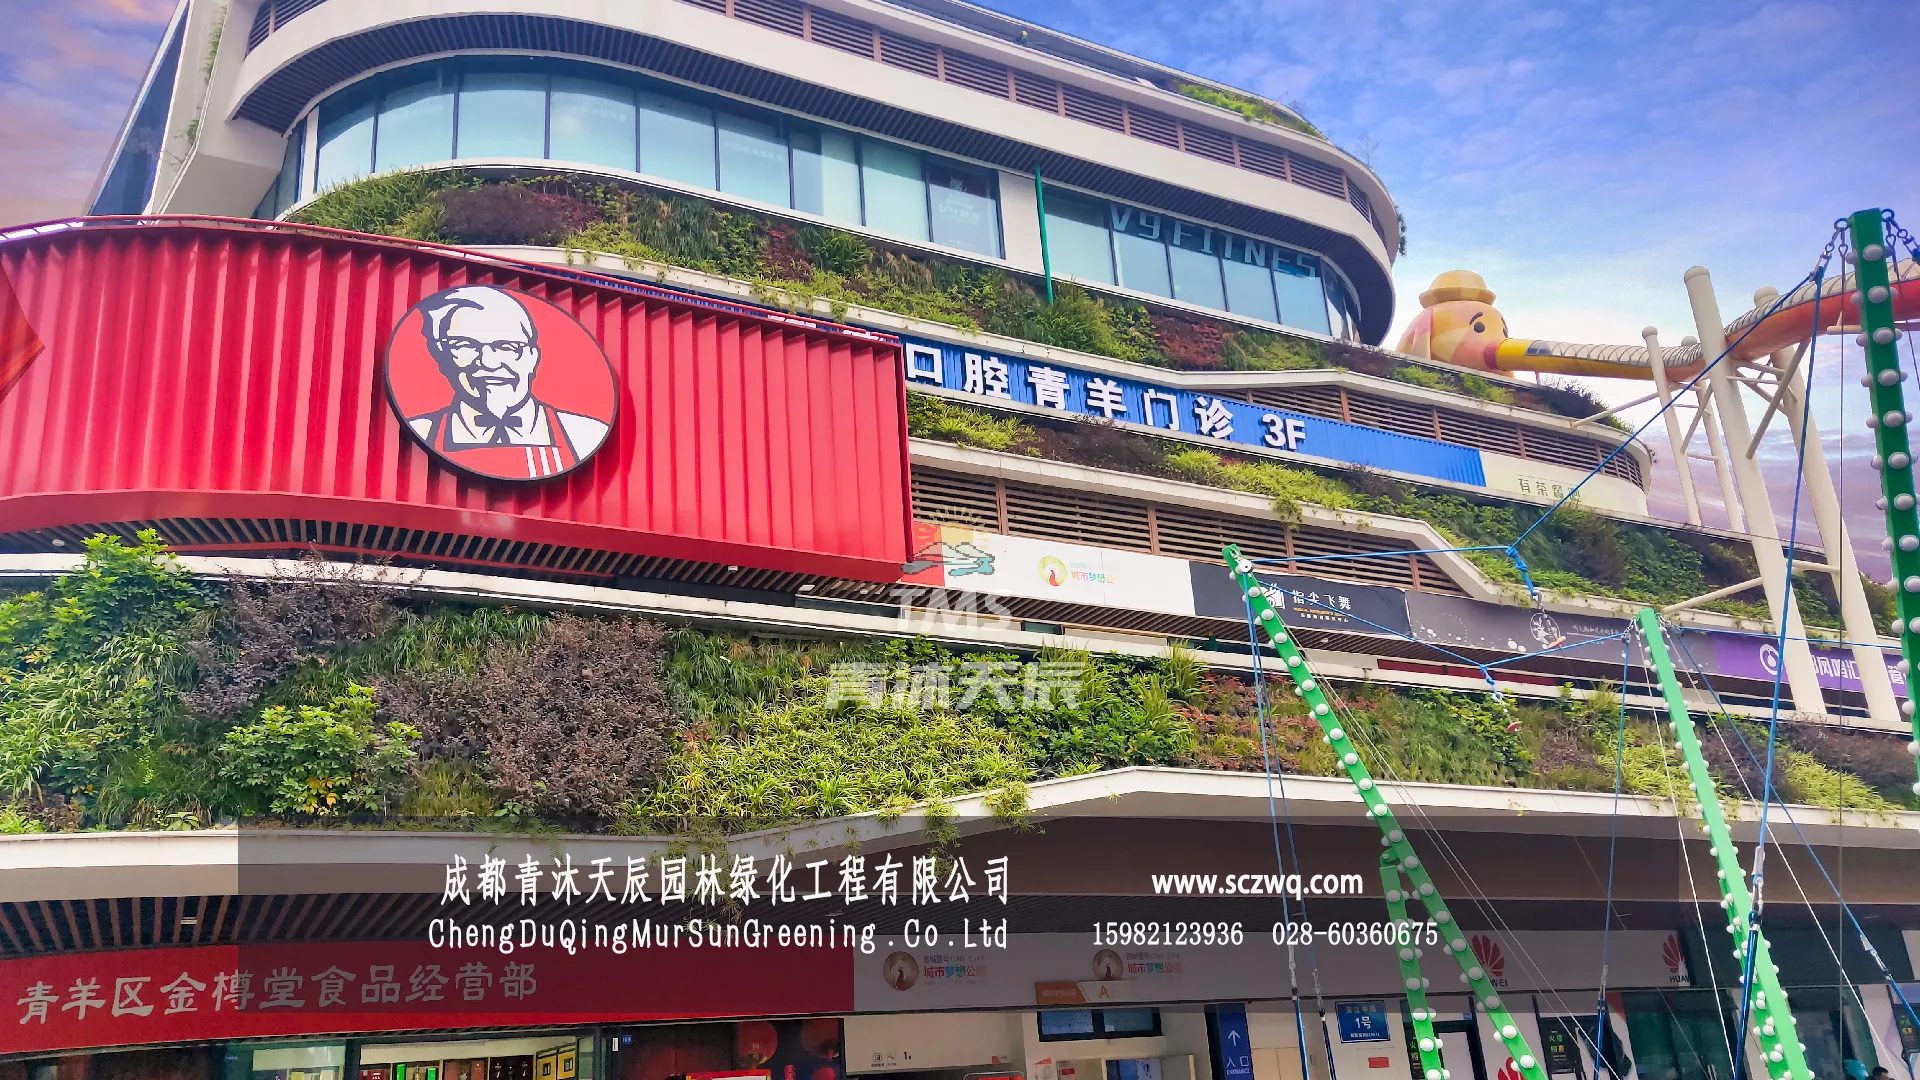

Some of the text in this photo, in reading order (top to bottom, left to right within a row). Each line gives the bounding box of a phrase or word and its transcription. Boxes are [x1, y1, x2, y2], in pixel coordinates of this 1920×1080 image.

[905, 343, 1307, 450] 口腔青羊门诊 3F
[1070, 570, 1118, 584] 城市梦想公
[1292, 589, 1352, 611] 指尖飞舞
[17, 960, 537, 1025] 青羊区金樽堂食品经营部
[1355, 1015, 1372, 1030] 1号
[1225, 1055, 1250, 1069] 入口
